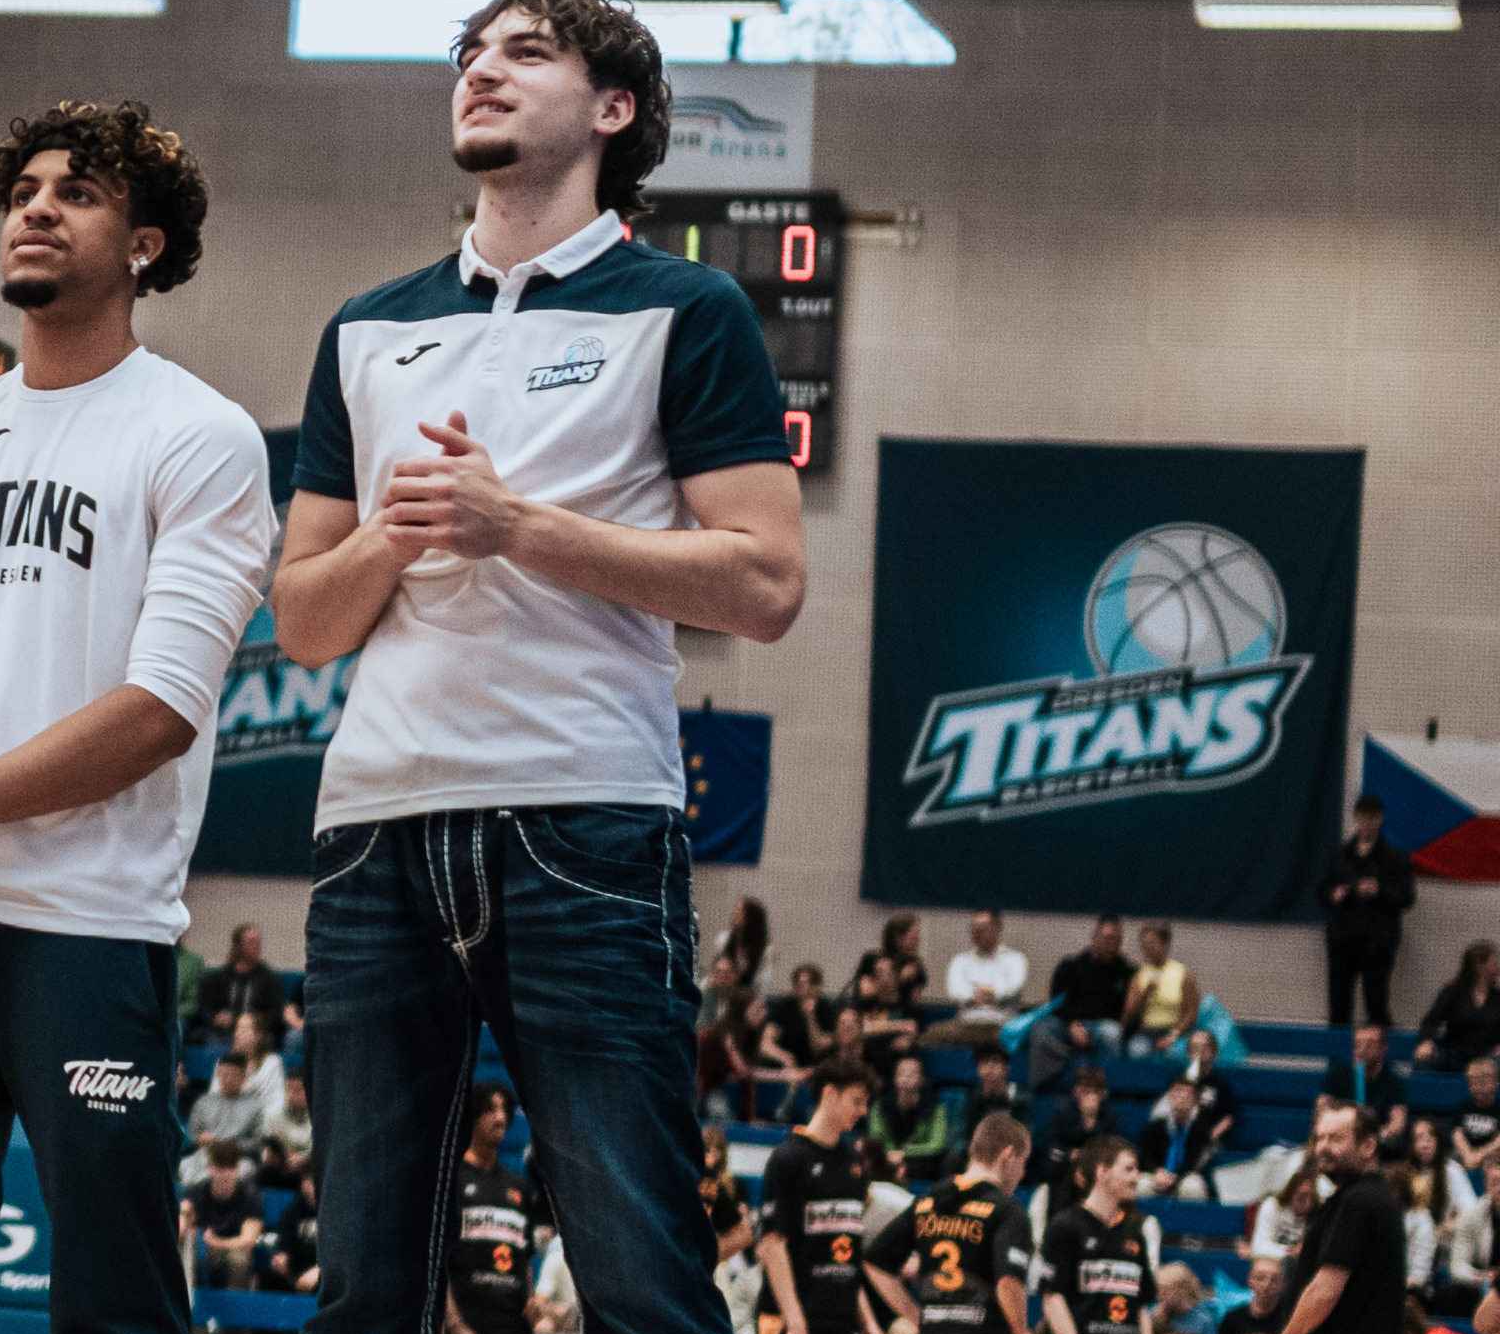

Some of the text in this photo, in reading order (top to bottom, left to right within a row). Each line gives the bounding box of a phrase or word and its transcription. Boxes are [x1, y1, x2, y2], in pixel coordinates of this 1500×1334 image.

[781, 225, 816, 281] 0
[929, 673, 1285, 803] TITANS
[63, 1058, 157, 1102] Titans
[931, 1239, 965, 1292] 3
